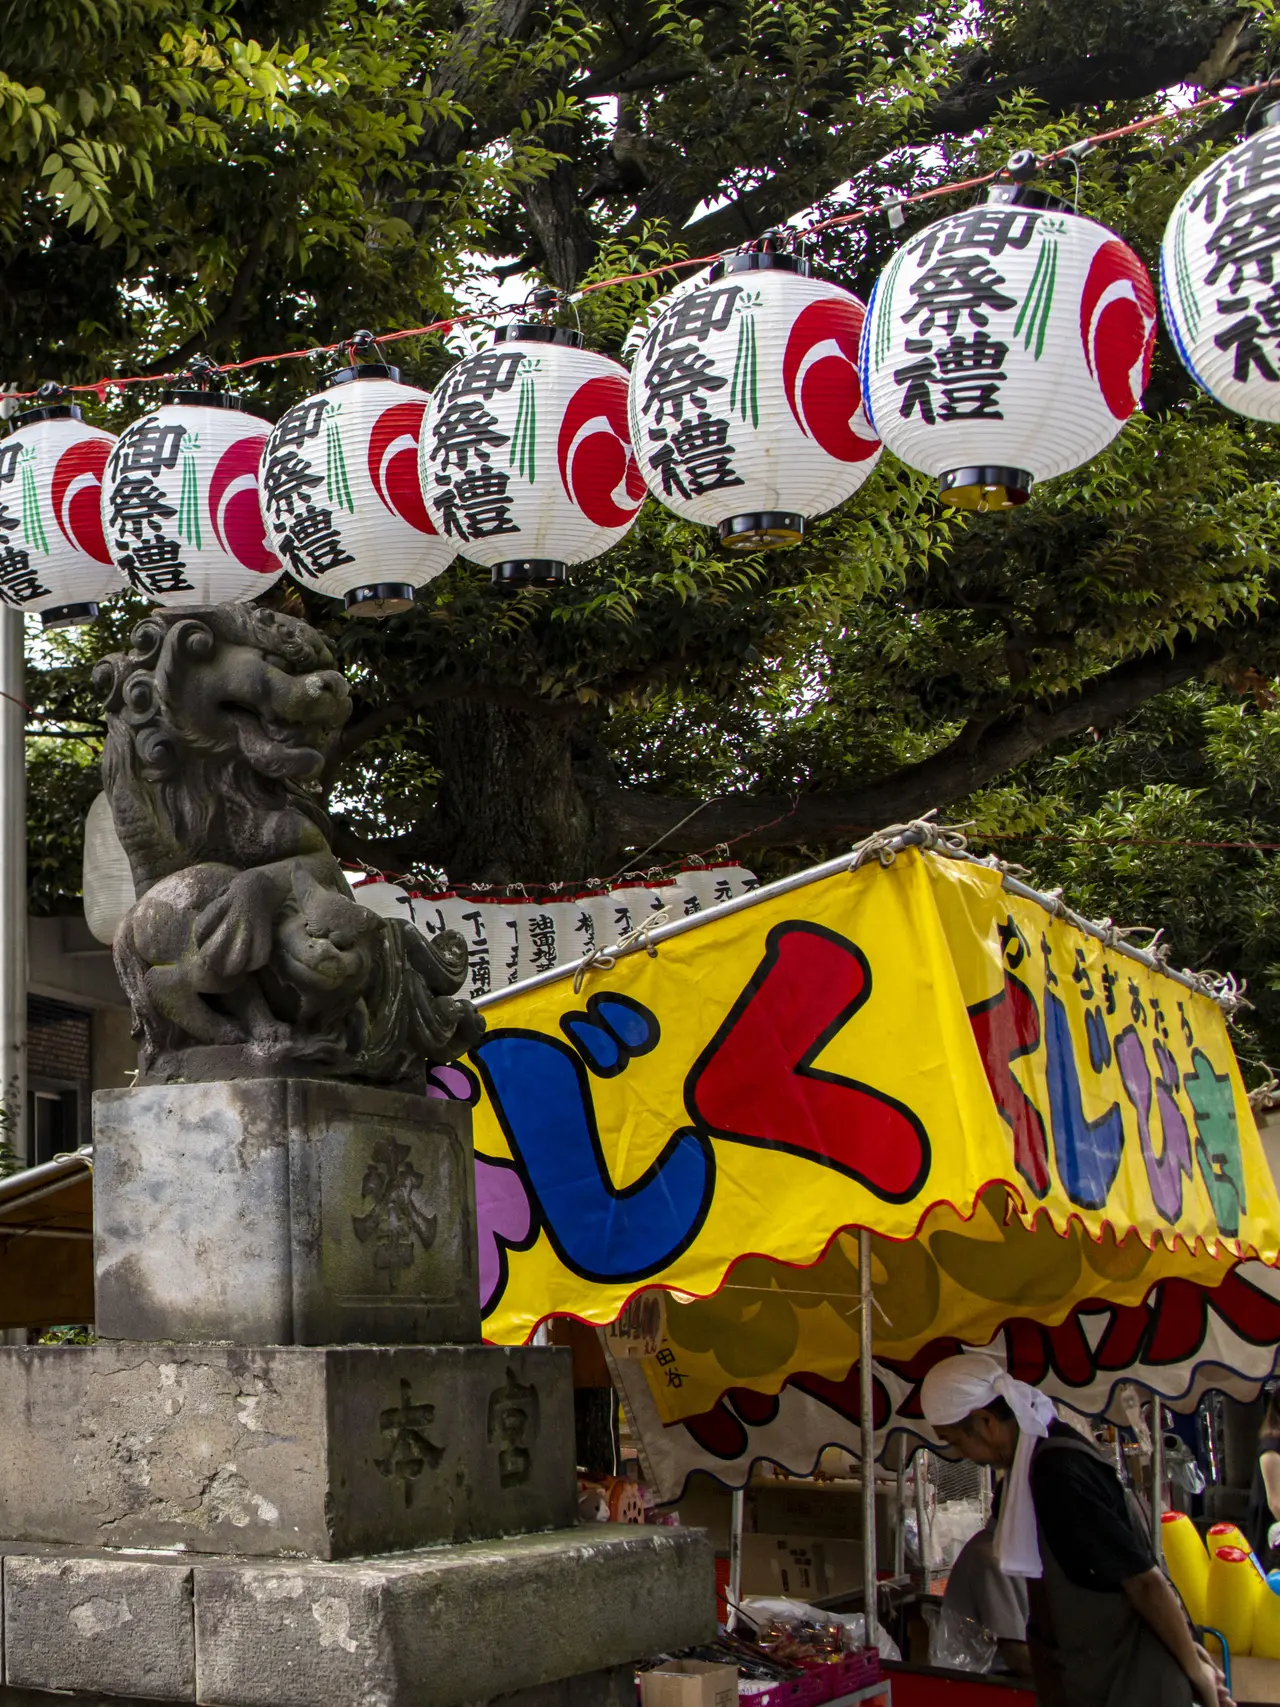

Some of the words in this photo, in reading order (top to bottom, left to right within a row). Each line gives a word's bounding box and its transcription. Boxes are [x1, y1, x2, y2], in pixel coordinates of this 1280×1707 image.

[641, 285, 745, 500] 御祭禮
[893, 210, 1044, 425] 御祭禮
[108, 417, 196, 596] 御祭禮
[263, 398, 355, 579] 御祭禮
[433, 351, 526, 543] 御祭禮
